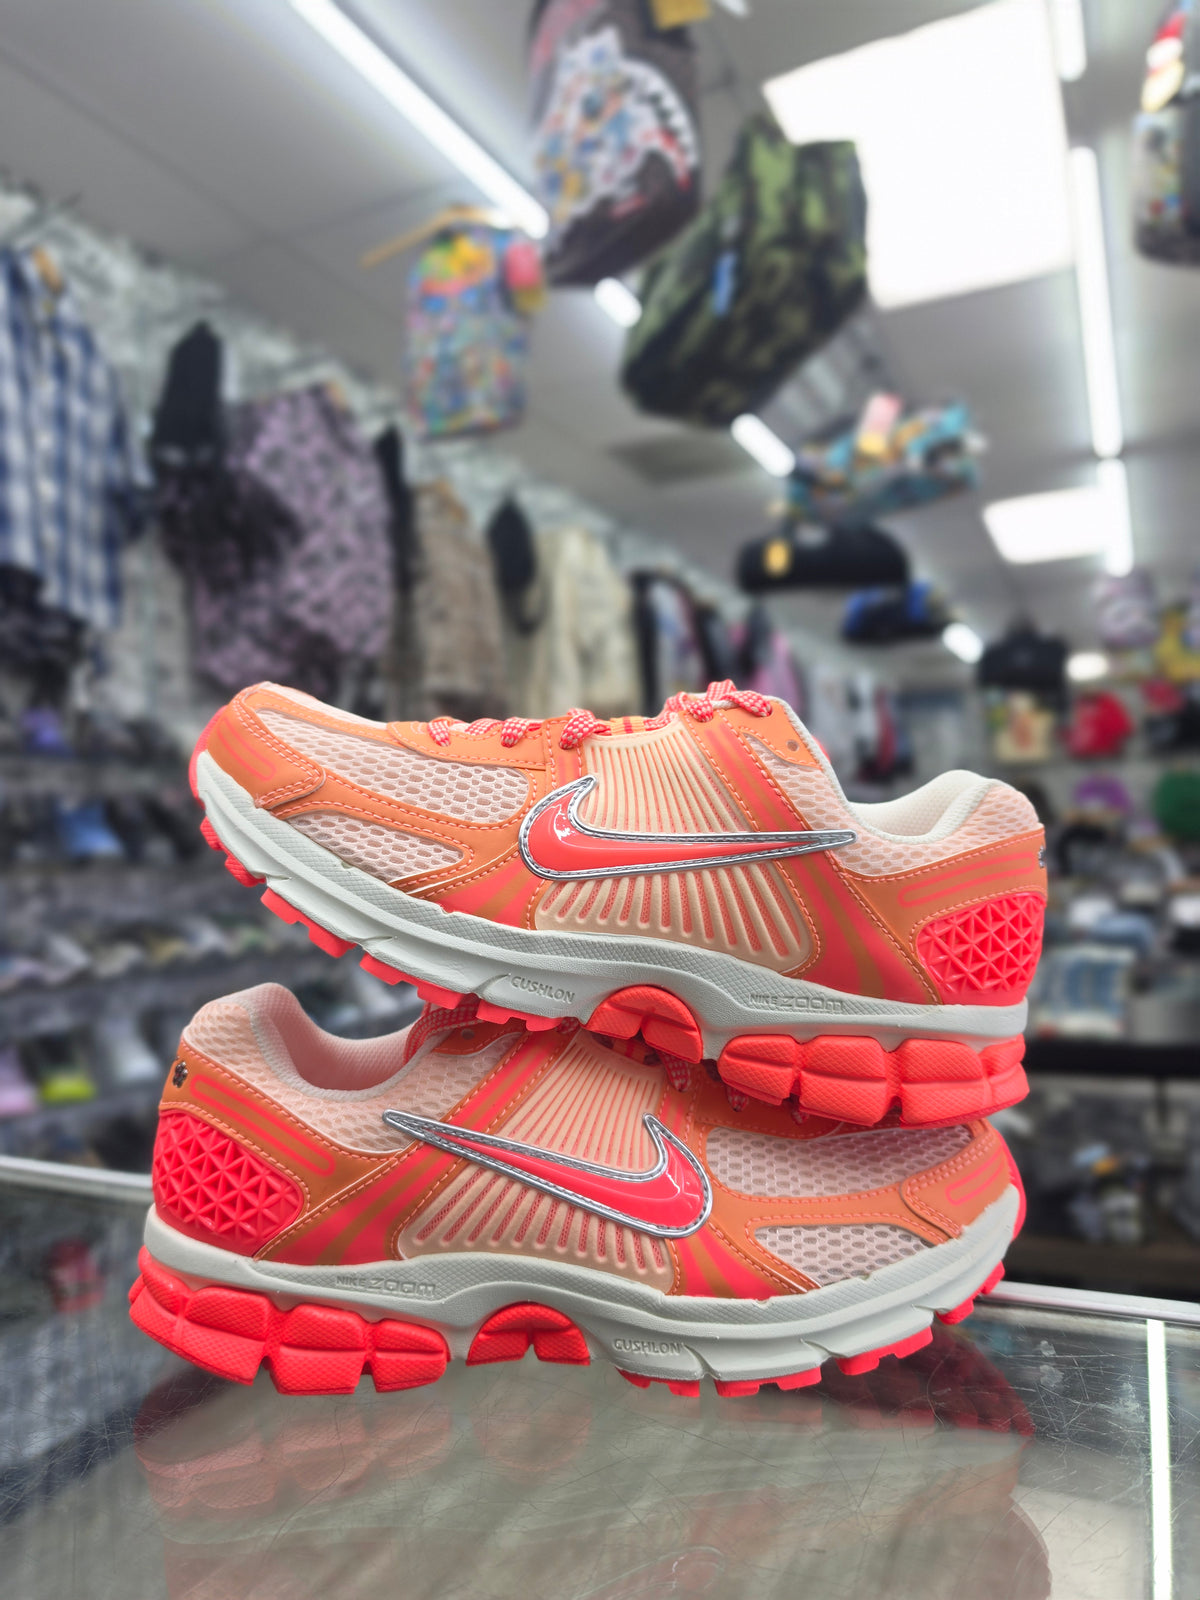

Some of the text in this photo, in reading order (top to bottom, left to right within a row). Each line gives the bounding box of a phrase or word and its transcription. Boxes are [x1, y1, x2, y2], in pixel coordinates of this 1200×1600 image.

[511, 976, 575, 1003] CUSHLON
[749, 993, 778, 1006] NIKE
[336, 1276, 367, 1288] NIKE
[613, 1338, 681, 1355] CUSHLON
